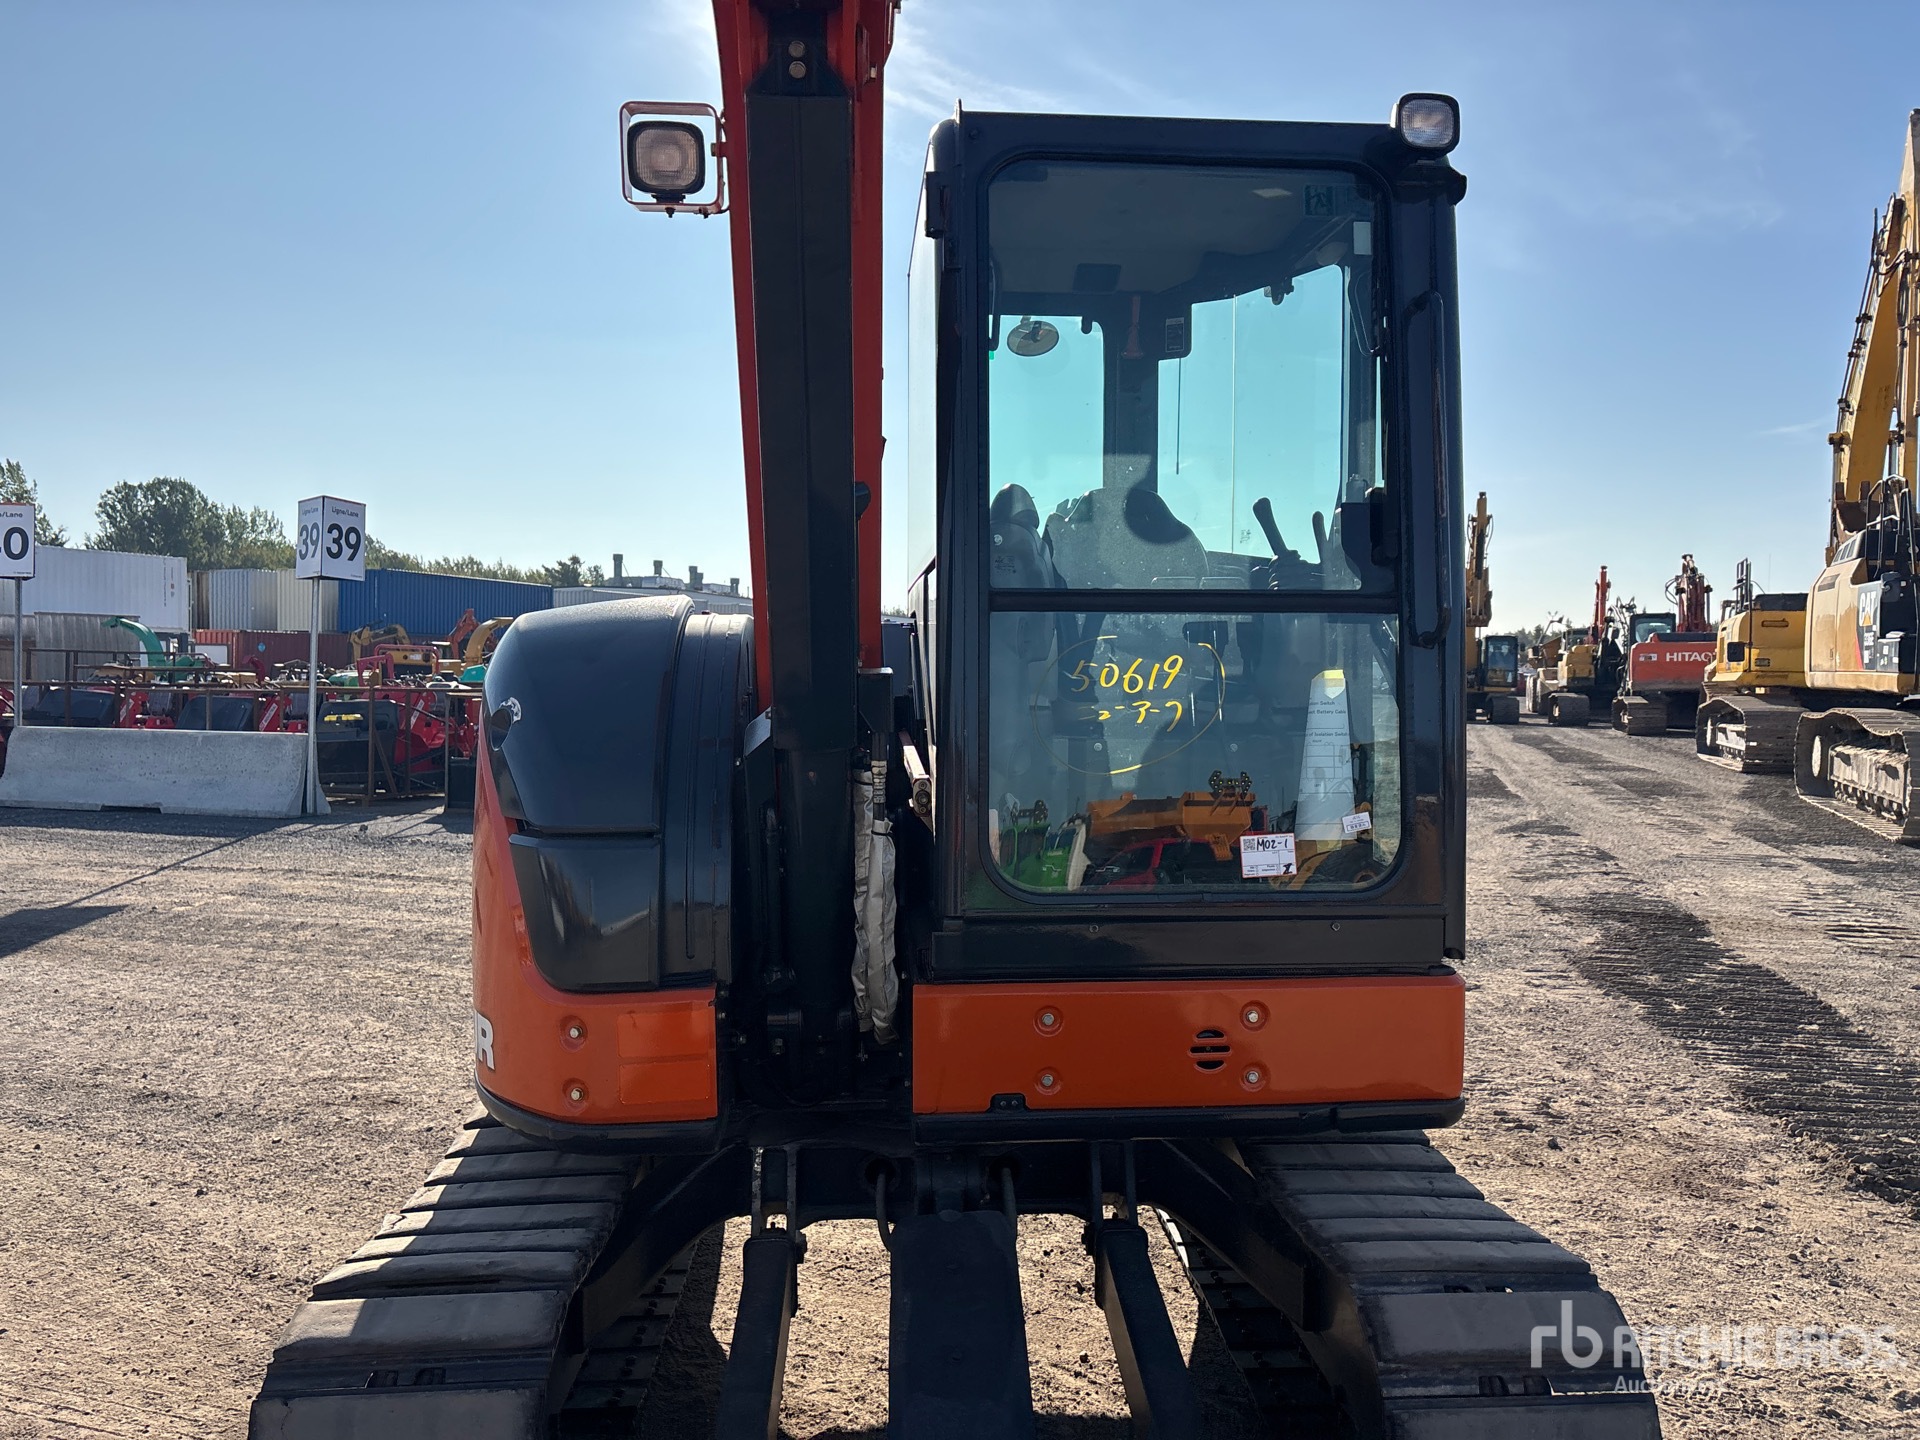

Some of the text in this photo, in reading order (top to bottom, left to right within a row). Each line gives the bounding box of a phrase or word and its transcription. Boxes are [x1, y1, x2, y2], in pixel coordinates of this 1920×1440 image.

[331, 505, 359, 518] Ligne/Lane
[0, 526, 30, 560] 0
[299, 522, 320, 560] 39
[326, 523, 361, 561] 39
[1859, 590, 1877, 627] CAT
[1070, 654, 1184, 693] 50619
